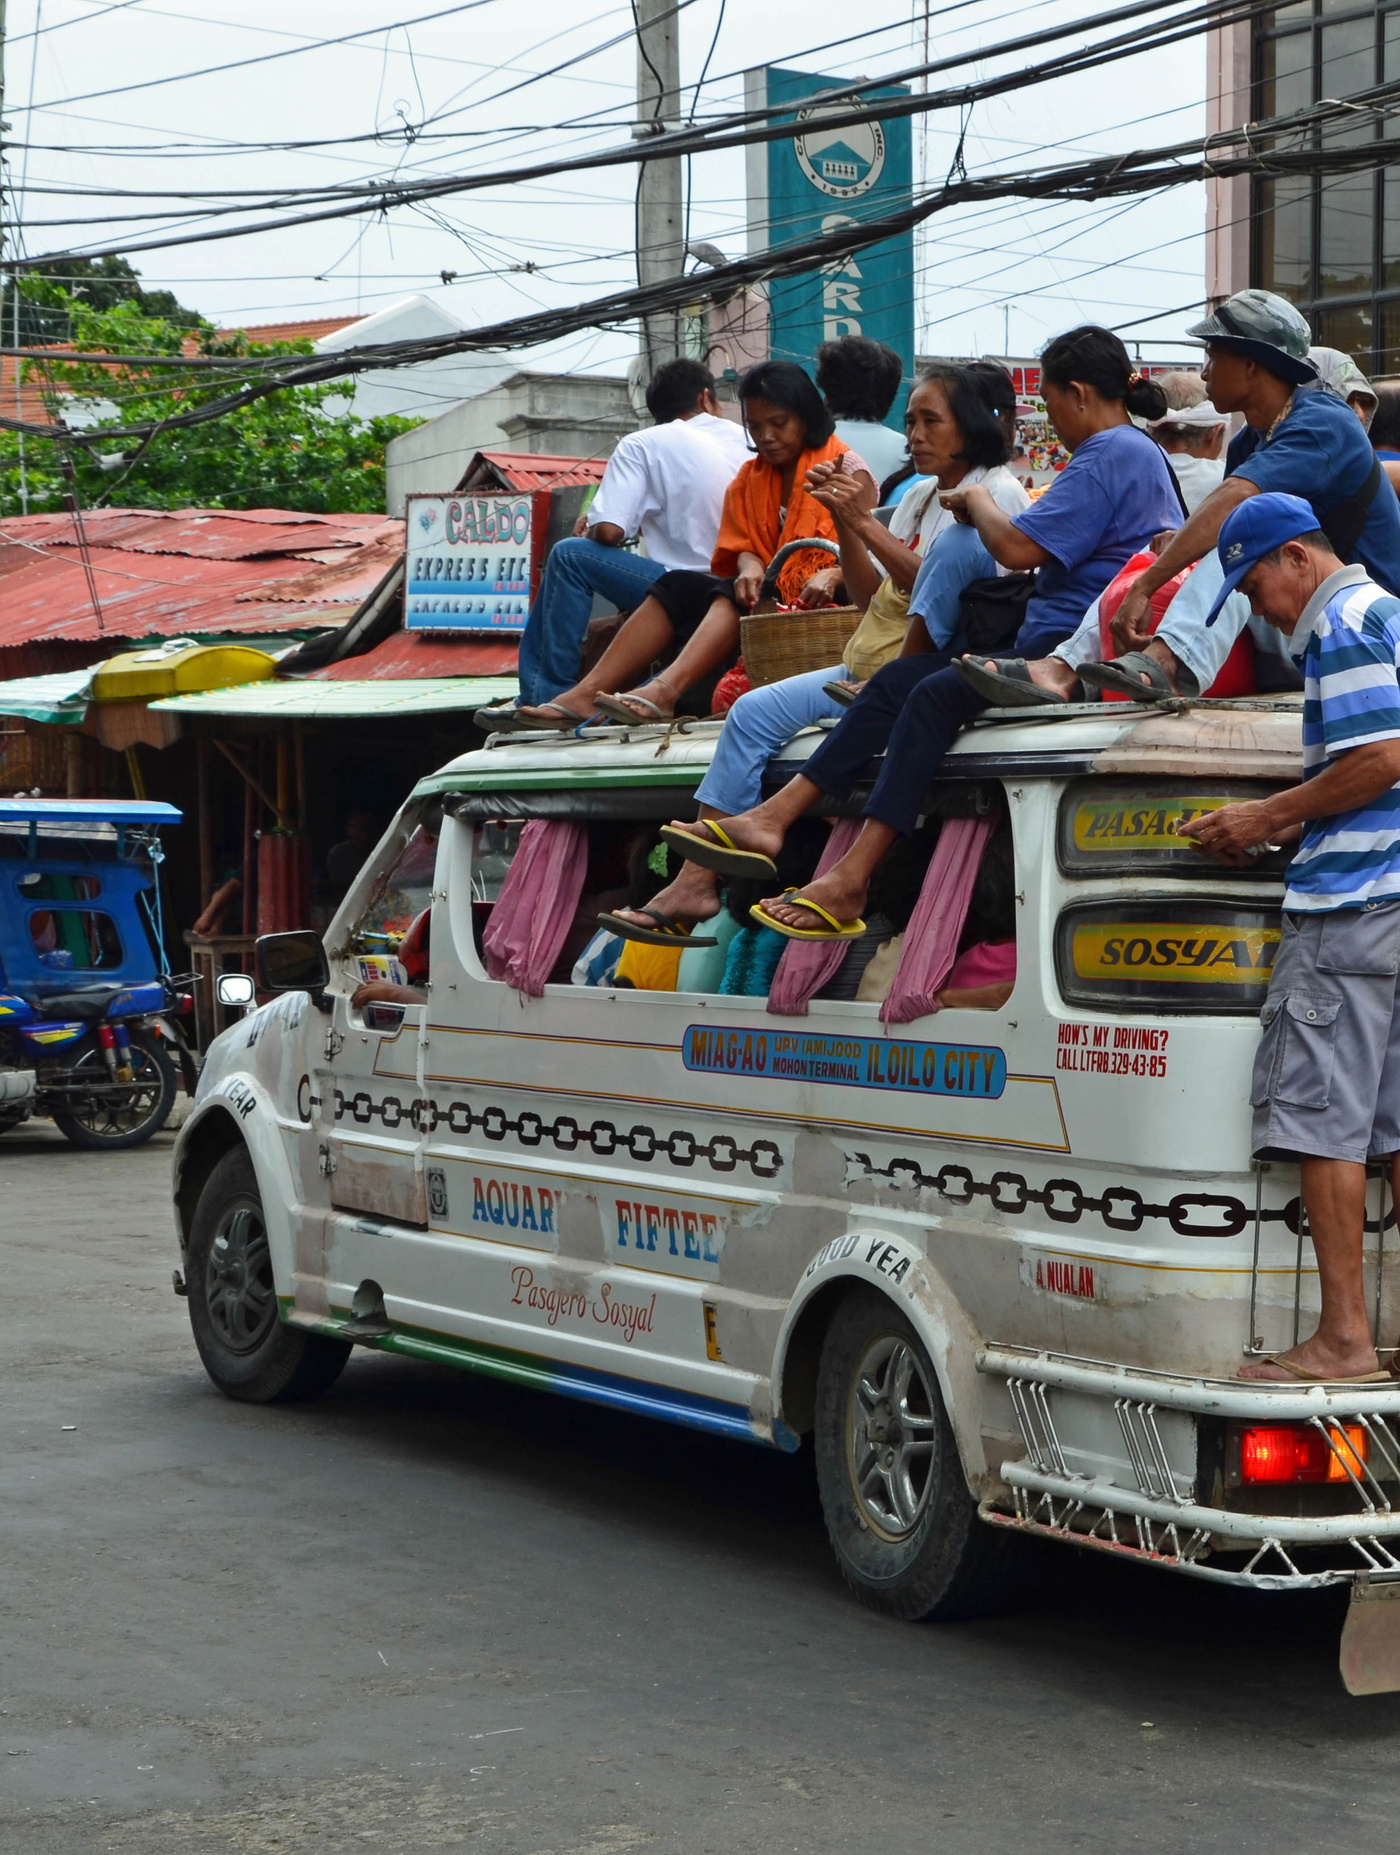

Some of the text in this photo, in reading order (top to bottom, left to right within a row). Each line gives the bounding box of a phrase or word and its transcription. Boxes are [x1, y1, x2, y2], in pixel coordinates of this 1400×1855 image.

[444, 500, 530, 546] CALDO
[774, 1036, 799, 1054] UPV
[1056, 1048, 1078, 1071] CALL
[1058, 1023, 1169, 1051] HOW'S MY DRIVING?
[690, 1029, 996, 1094] MIAG-AO ILOILO CITY
[772, 1056, 860, 1081] MOHON TERMINAL
[222, 1078, 257, 1120] YEAR
[472, 1177, 572, 1234] AQUAR
[615, 1199, 724, 1264] FIFTEE
[863, 1237, 912, 1286] YEA
[511, 1266, 587, 1326] Pasajero
[592, 1282, 657, 1343] Sosyal
